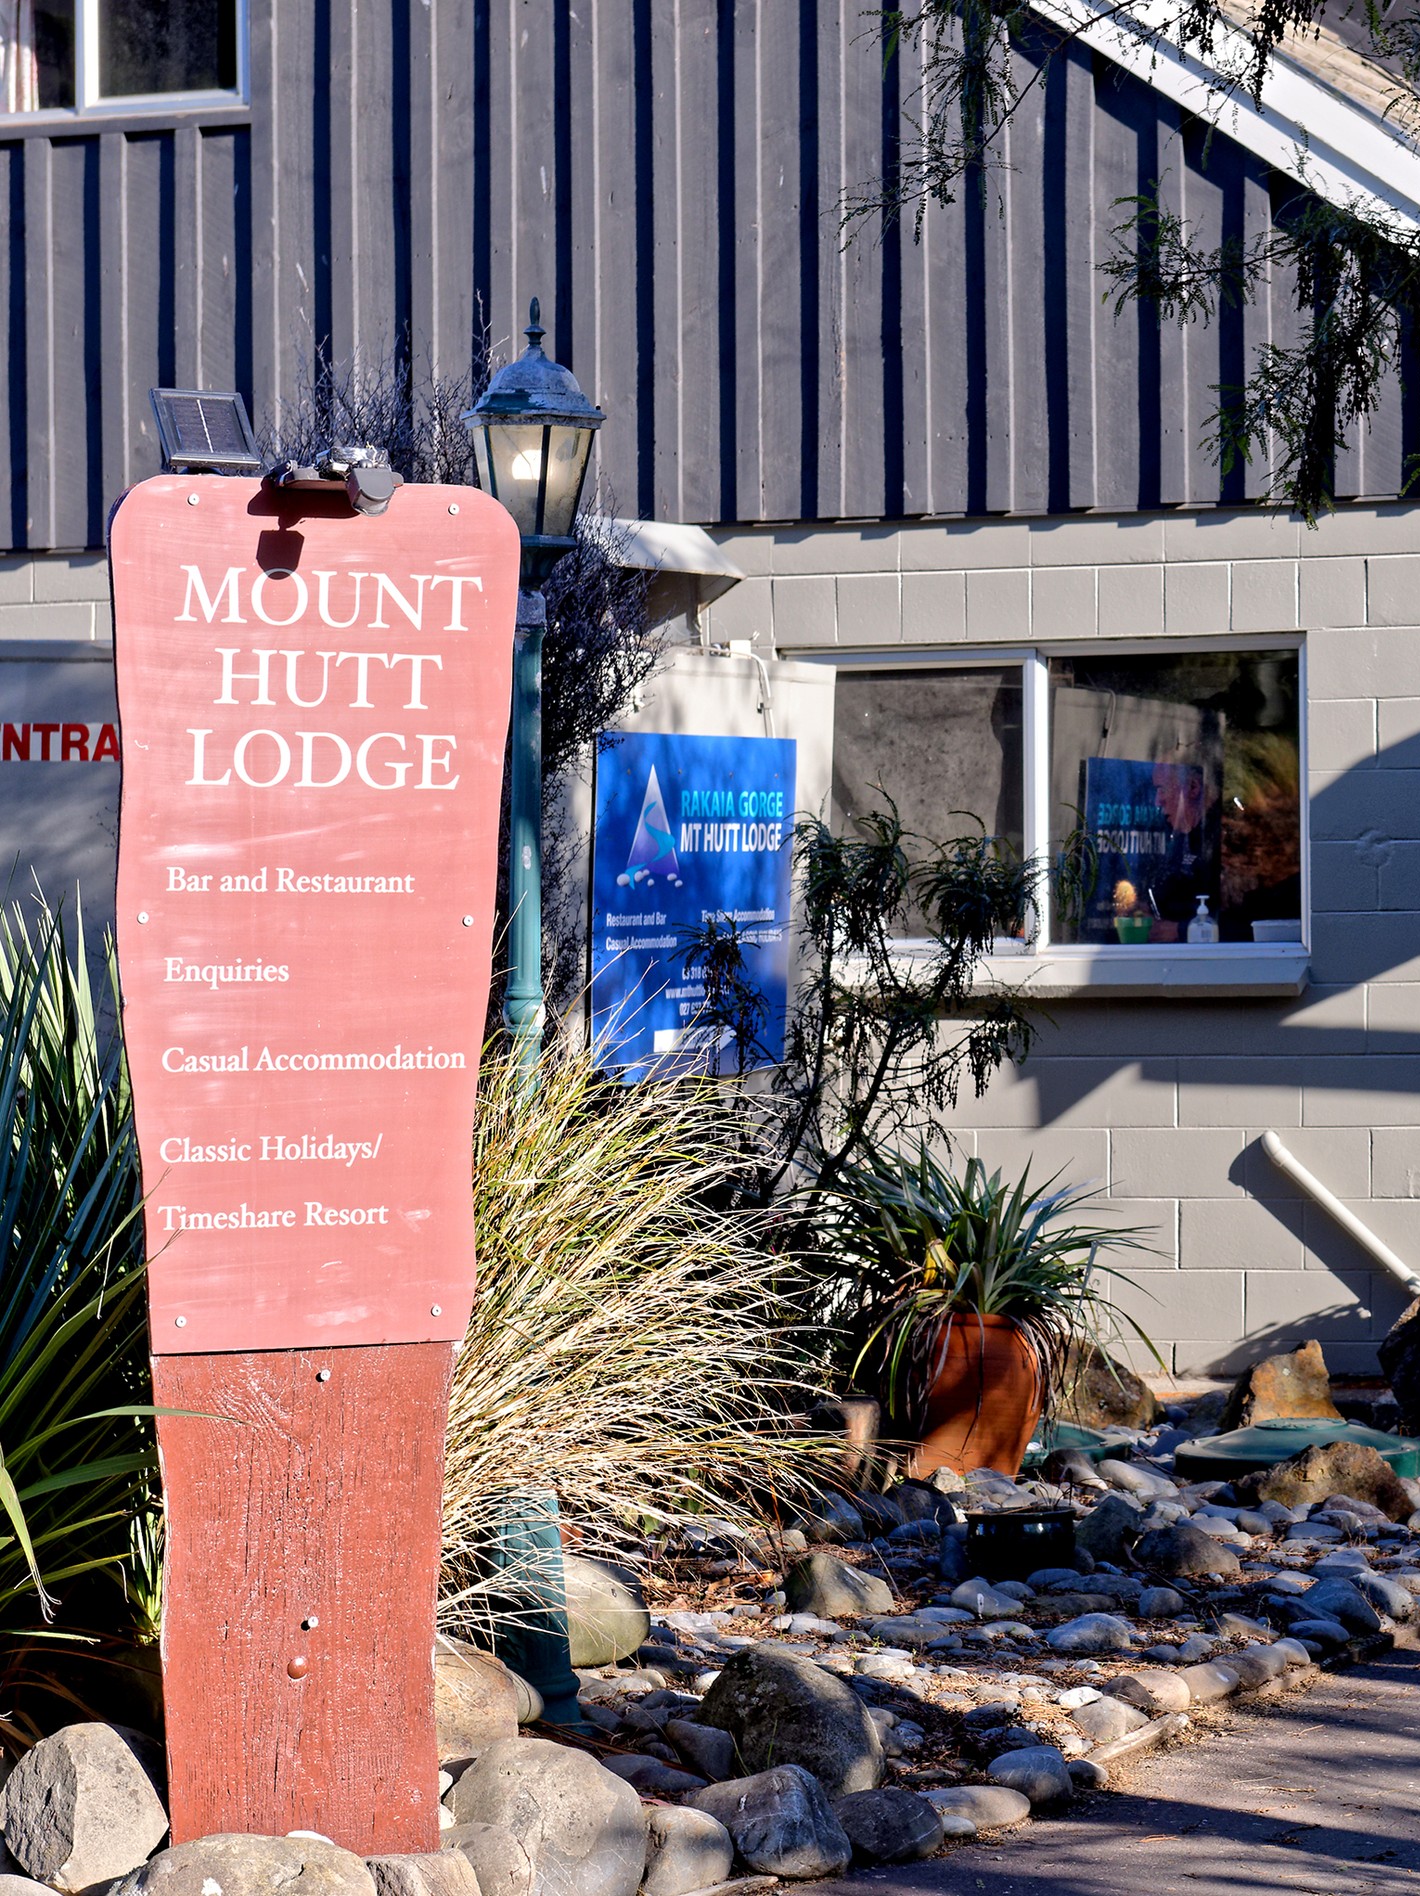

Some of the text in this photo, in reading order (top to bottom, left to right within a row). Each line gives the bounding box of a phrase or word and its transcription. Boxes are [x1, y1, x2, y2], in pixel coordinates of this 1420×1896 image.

[174, 564, 483, 632] MOUNT
[212, 647, 444, 710] HUTT
[0, 722, 121, 762] NTRA
[185, 728, 460, 790] LODGE
[681, 790, 783, 818] RAKAIA GORGE
[680, 823, 783, 853] MT HUTT LODGE
[165, 866, 416, 893] Bar and Restaurant
[606, 911, 667, 927] Restaurant and Bar
[733, 907, 776, 922] Accommodation
[605, 934, 678, 951] Casual Accommodation
[163, 957, 290, 991] Enquiries
[679, 1002, 691, 1017] 027
[161, 1044, 467, 1074] Casual Accommodation
[159, 1133, 384, 1168] Classic Holidays/
[157, 1201, 389, 1231] Timeshare Resort
